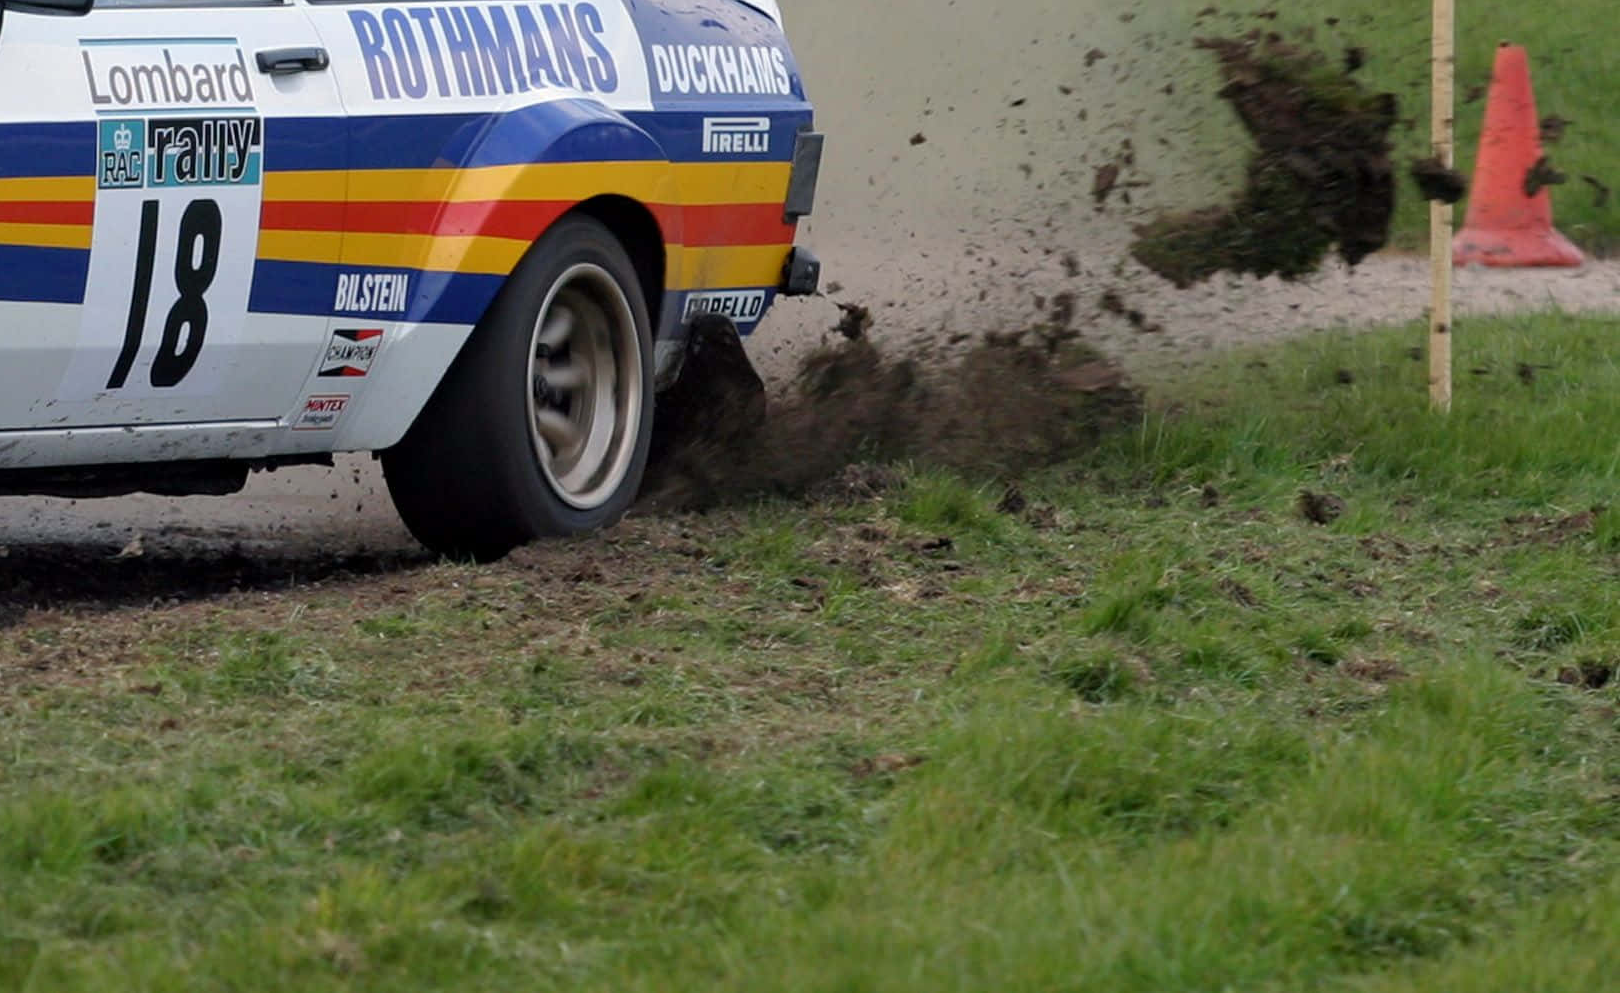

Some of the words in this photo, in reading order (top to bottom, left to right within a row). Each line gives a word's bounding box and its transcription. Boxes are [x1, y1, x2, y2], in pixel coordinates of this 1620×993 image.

[82, 48, 254, 104] Lombard
[347, 2, 620, 100] ROTHMANS
[652, 44, 791, 96] DUCKHAMS
[154, 119, 255, 183] rally
[701, 117, 770, 153] PIRELLI
[101, 152, 142, 184] RAC
[106, 198, 223, 389] 18
[334, 274, 408, 312] BILSTEIN
